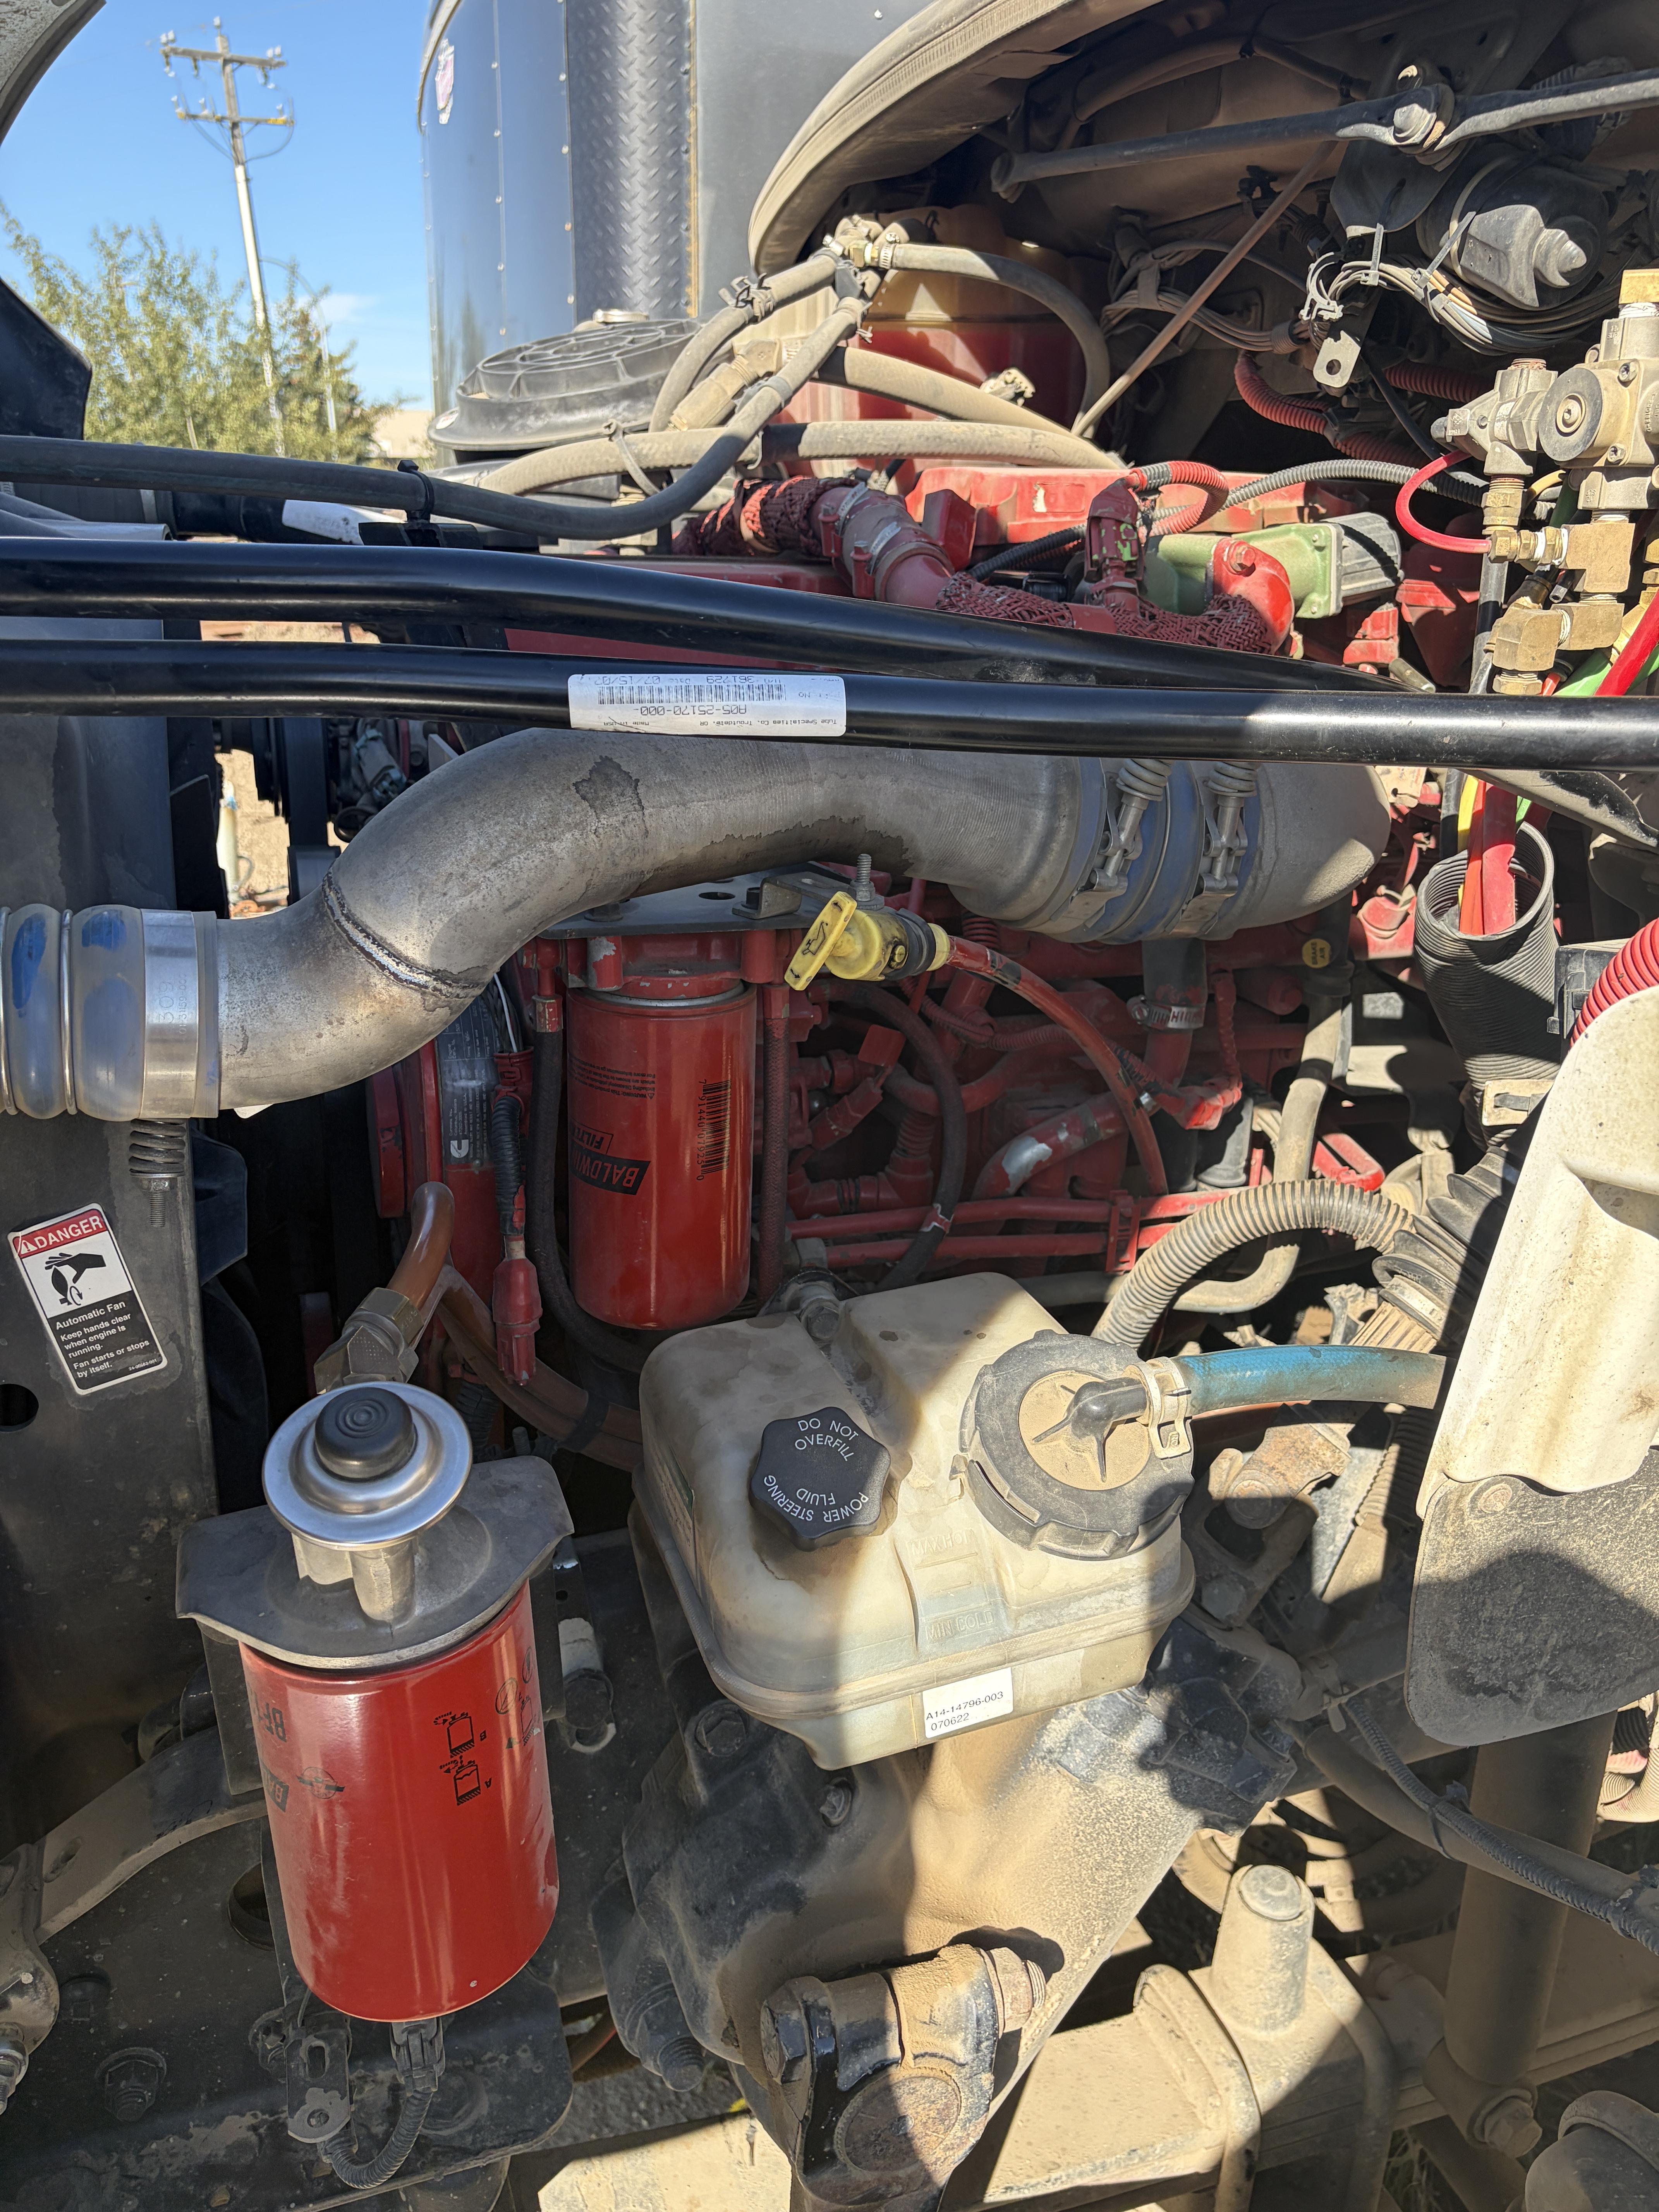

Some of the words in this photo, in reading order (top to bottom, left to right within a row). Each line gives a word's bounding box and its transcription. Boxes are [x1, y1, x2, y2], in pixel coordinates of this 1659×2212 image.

[706, 675, 755, 684] 361729
[697, 1095, 706, 1128] 91440
[697, 1133, 706, 1165] 07925
[34, 1216, 103, 1249] DANGER
[56, 1308, 106, 1330] Automatic
[106, 1301, 126, 1312] Fan
[60, 1330, 82, 1342] Keep
[83, 1321, 110, 1334] hands
[111, 1313, 131, 1325] clear
[64, 1338, 88, 1350] when
[88, 1328, 117, 1340] engine
[68, 1344, 103, 1358] running.
[73, 1360, 90, 1370] Fan
[91, 1352, 115, 1364] starts
[126, 1340, 150, 1352] stops
[77, 1370, 88, 1378] by
[89, 1361, 113, 1374] itself.
[798, 1418, 821, 1432] DO
[830, 1420, 859, 1441] NOT
[795, 1434, 854, 1462] OVERFILL
[764, 1475, 814, 1522] STEERING
[796, 1488, 836, 1506] FLUID
[823, 1492, 869, 1523] POWER
[925, 1619, 955, 1642] MIN
[956, 1609, 995, 1632] COLD
[926, 1691, 1003, 1721] A14-14796-003
[931, 1712, 970, 1731] 070622
